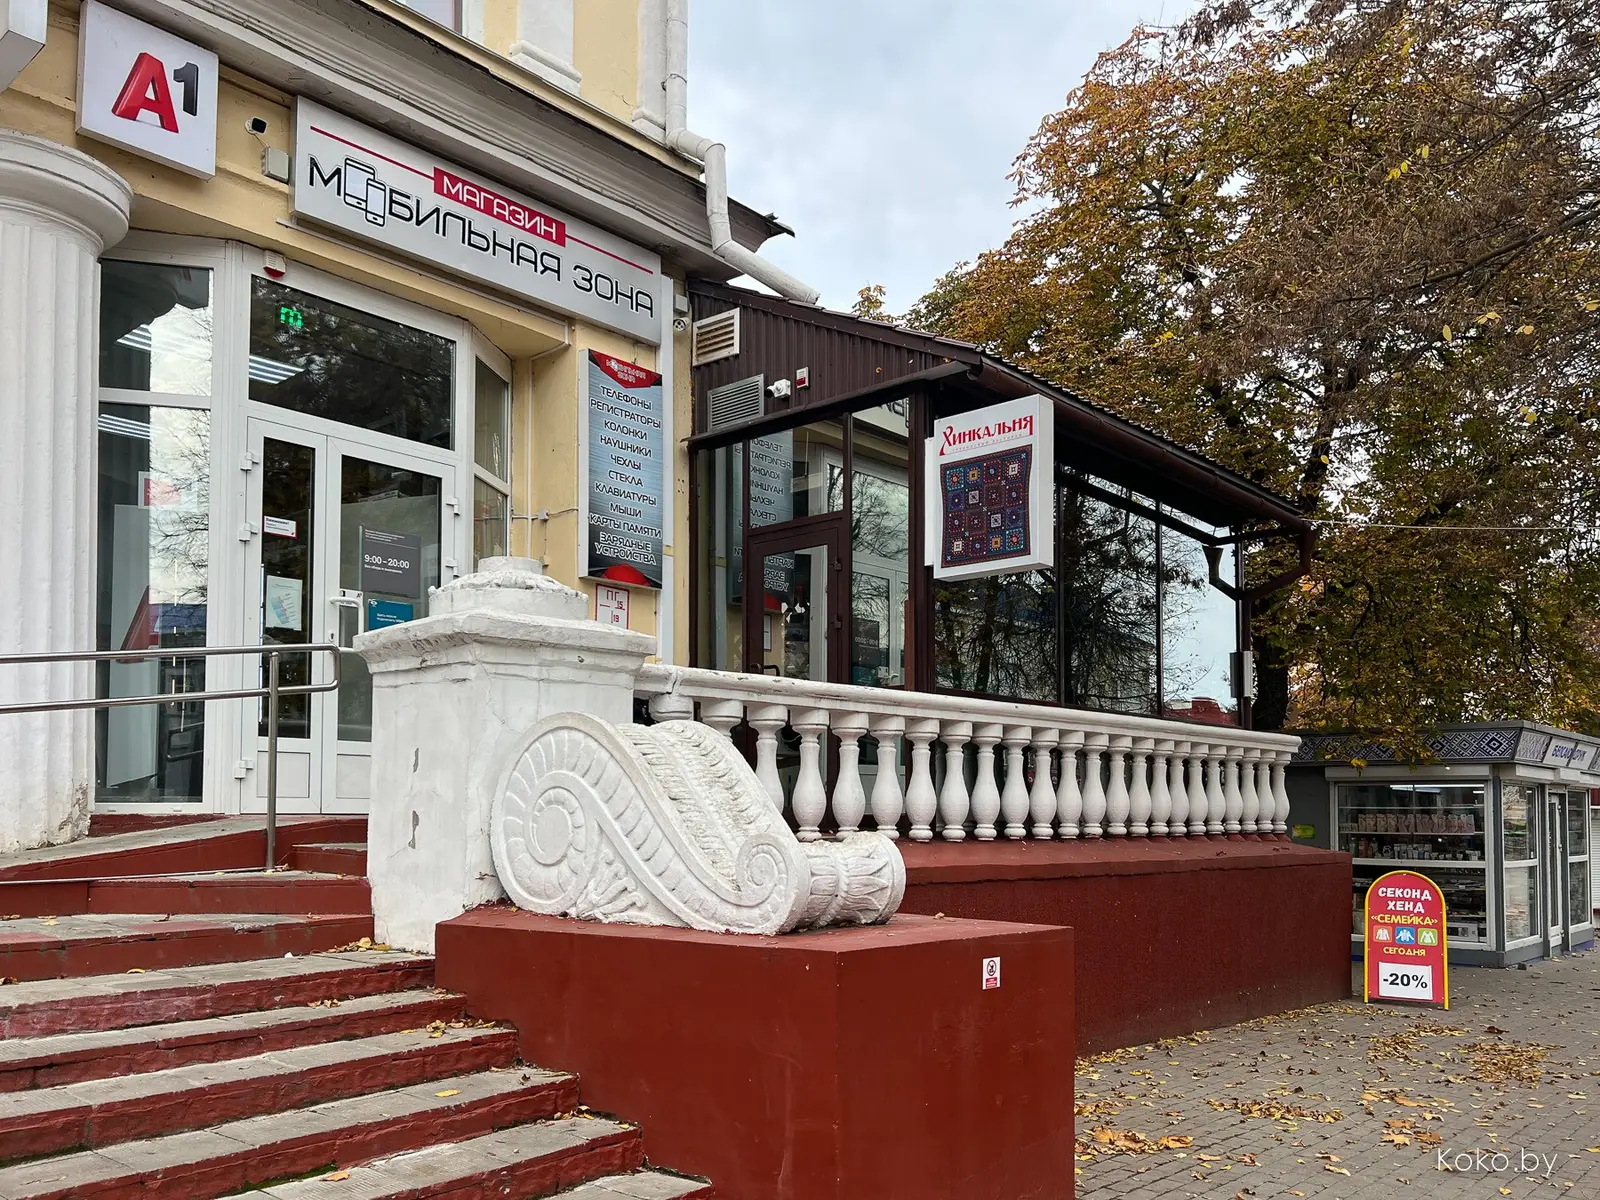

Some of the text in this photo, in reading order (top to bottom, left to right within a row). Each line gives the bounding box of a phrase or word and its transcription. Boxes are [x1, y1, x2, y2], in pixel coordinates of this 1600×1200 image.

[111, 52, 199, 133] A1
[443, 175, 557, 240] МАГАЗИН
[573, 264, 654, 319] ЗОНА
[600, 385, 652, 411] ТЕЛЕФОНЫ
[590, 398, 661, 429] РЕГИСТРАТОРЫ
[604, 420, 648, 441] КОЛОНКИ
[939, 415, 1033, 456] ХИНКАЛЬНЯ
[600, 434, 652, 458] НАУШНИКИ
[610, 453, 642, 471] ЧЕХЛЫ
[608, 469, 644, 487] СТЕКЛА
[595, 482, 657, 506] КЛАВИАТУРЫ
[609, 502, 642, 518] МЫШИ
[589, 513, 662, 539] КАРТЫ ПАМЯТИ
[600, 532, 651, 553] ЗАРЯДНЫЕ
[594, 542, 657, 566] УСТРОЙСТВА
[606, 590, 620, 601] ПГ
[1378, 887, 1432, 901] СЕКОНД
[1386, 900, 1425, 913] ХЕНД
[1371, 914, 1438, 925] «СЕМЕЙКА»
[1383, 946, 1426, 956] СЕГОДНЯ
[1383, 973, 1428, 989] -20%
